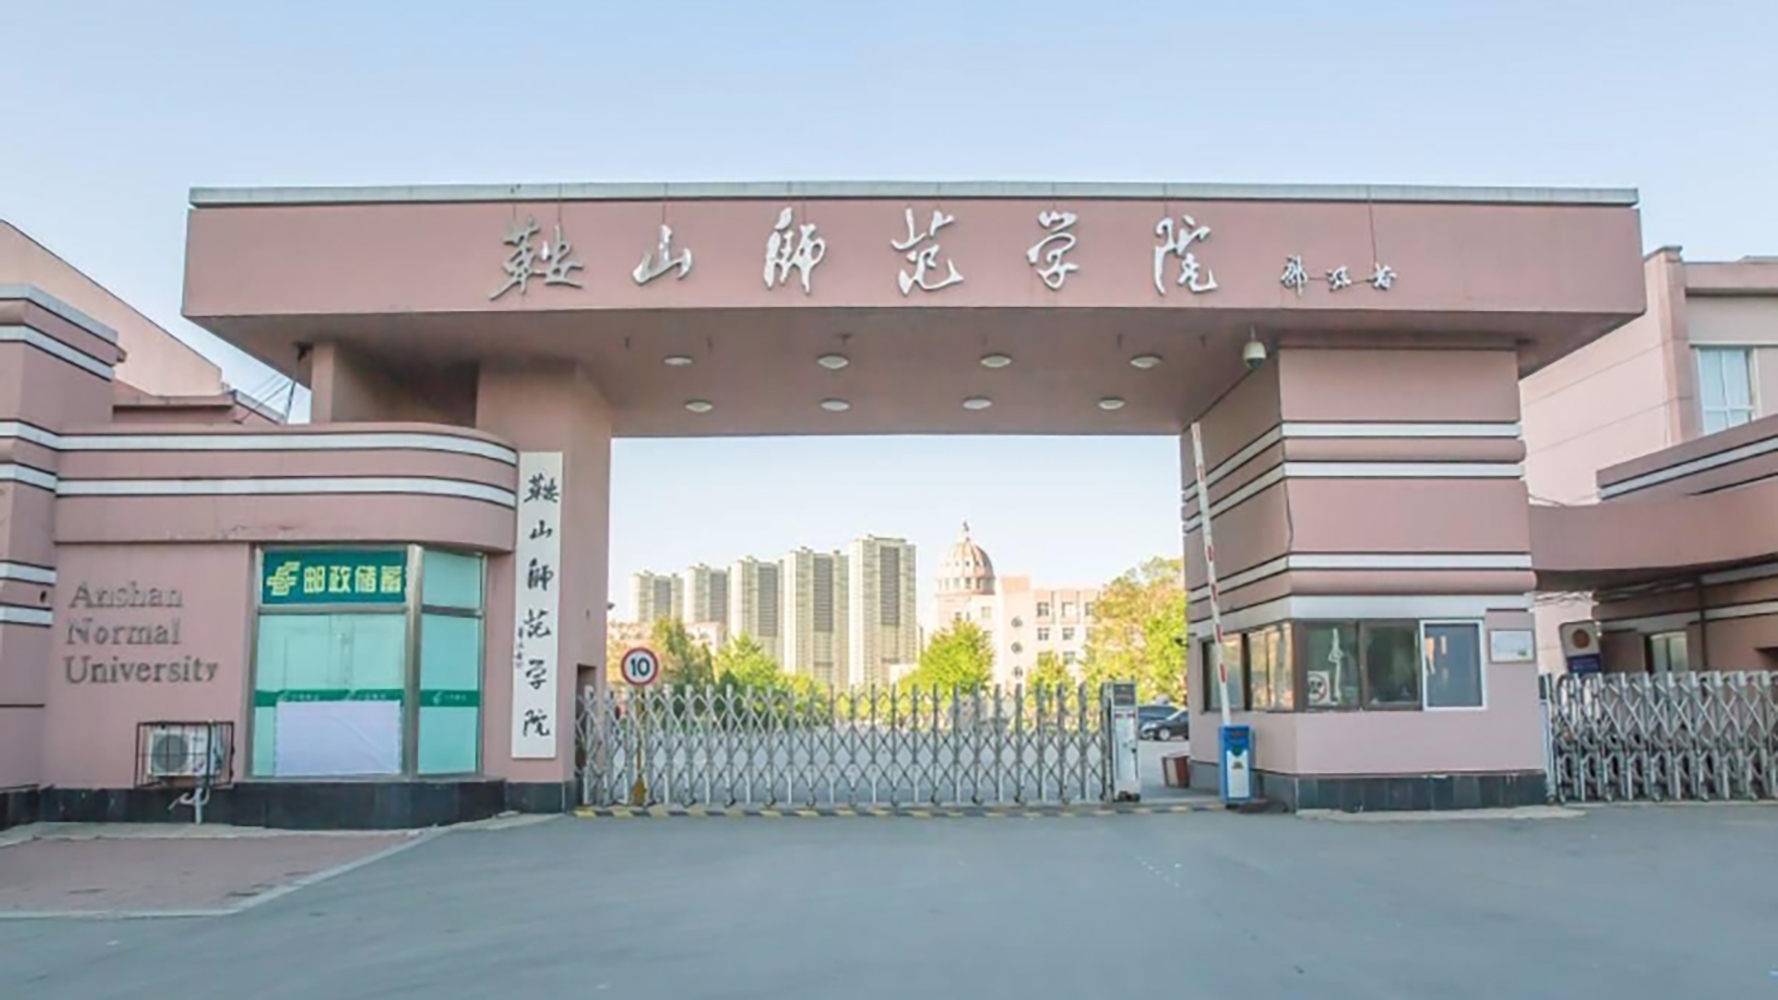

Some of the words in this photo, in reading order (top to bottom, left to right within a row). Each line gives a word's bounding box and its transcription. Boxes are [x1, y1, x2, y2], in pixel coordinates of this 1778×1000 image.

[67, 580, 183, 608] Anshan
[303, 565, 402, 594] 邮政储蓄
[66, 616, 181, 645] Normal
[63, 654, 218, 684] University
[630, 656, 650, 678] 10
